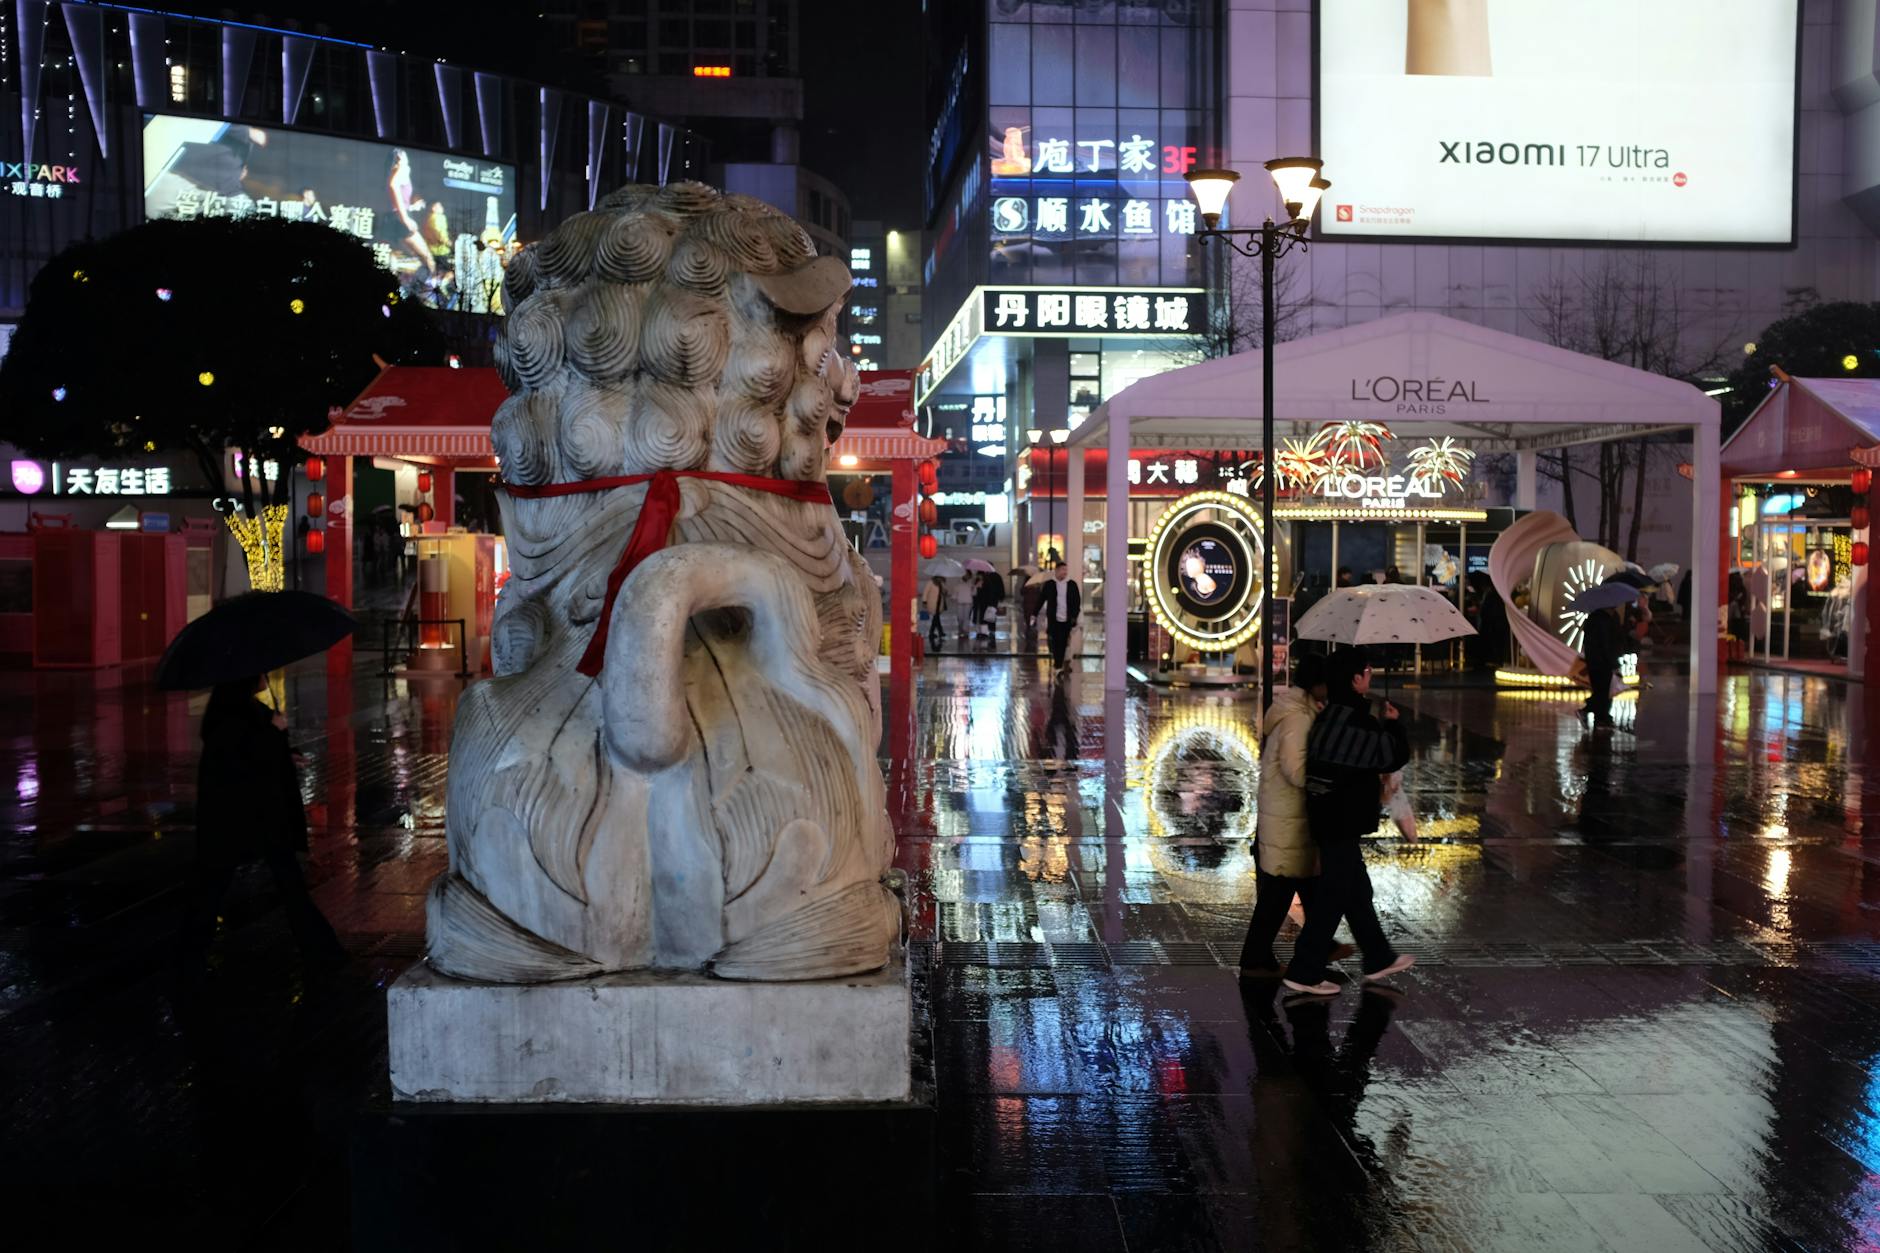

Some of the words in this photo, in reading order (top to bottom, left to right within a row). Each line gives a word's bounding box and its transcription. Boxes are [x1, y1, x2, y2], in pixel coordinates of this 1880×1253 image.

[1033, 134, 1156, 173] 庖丁家
[1163, 146, 1196, 174] 3F
[1439, 141, 1565, 166] xiaomi
[1577, 145, 1600, 167] 17
[1608, 145, 1669, 168] Ultra
[1036, 198, 1197, 234] 顺水鱼馆
[995, 294, 1189, 330] 丹阳眼镜城
[1352, 376, 1490, 402] L'ORÉAL
[66, 467, 170, 494] 天友生活
